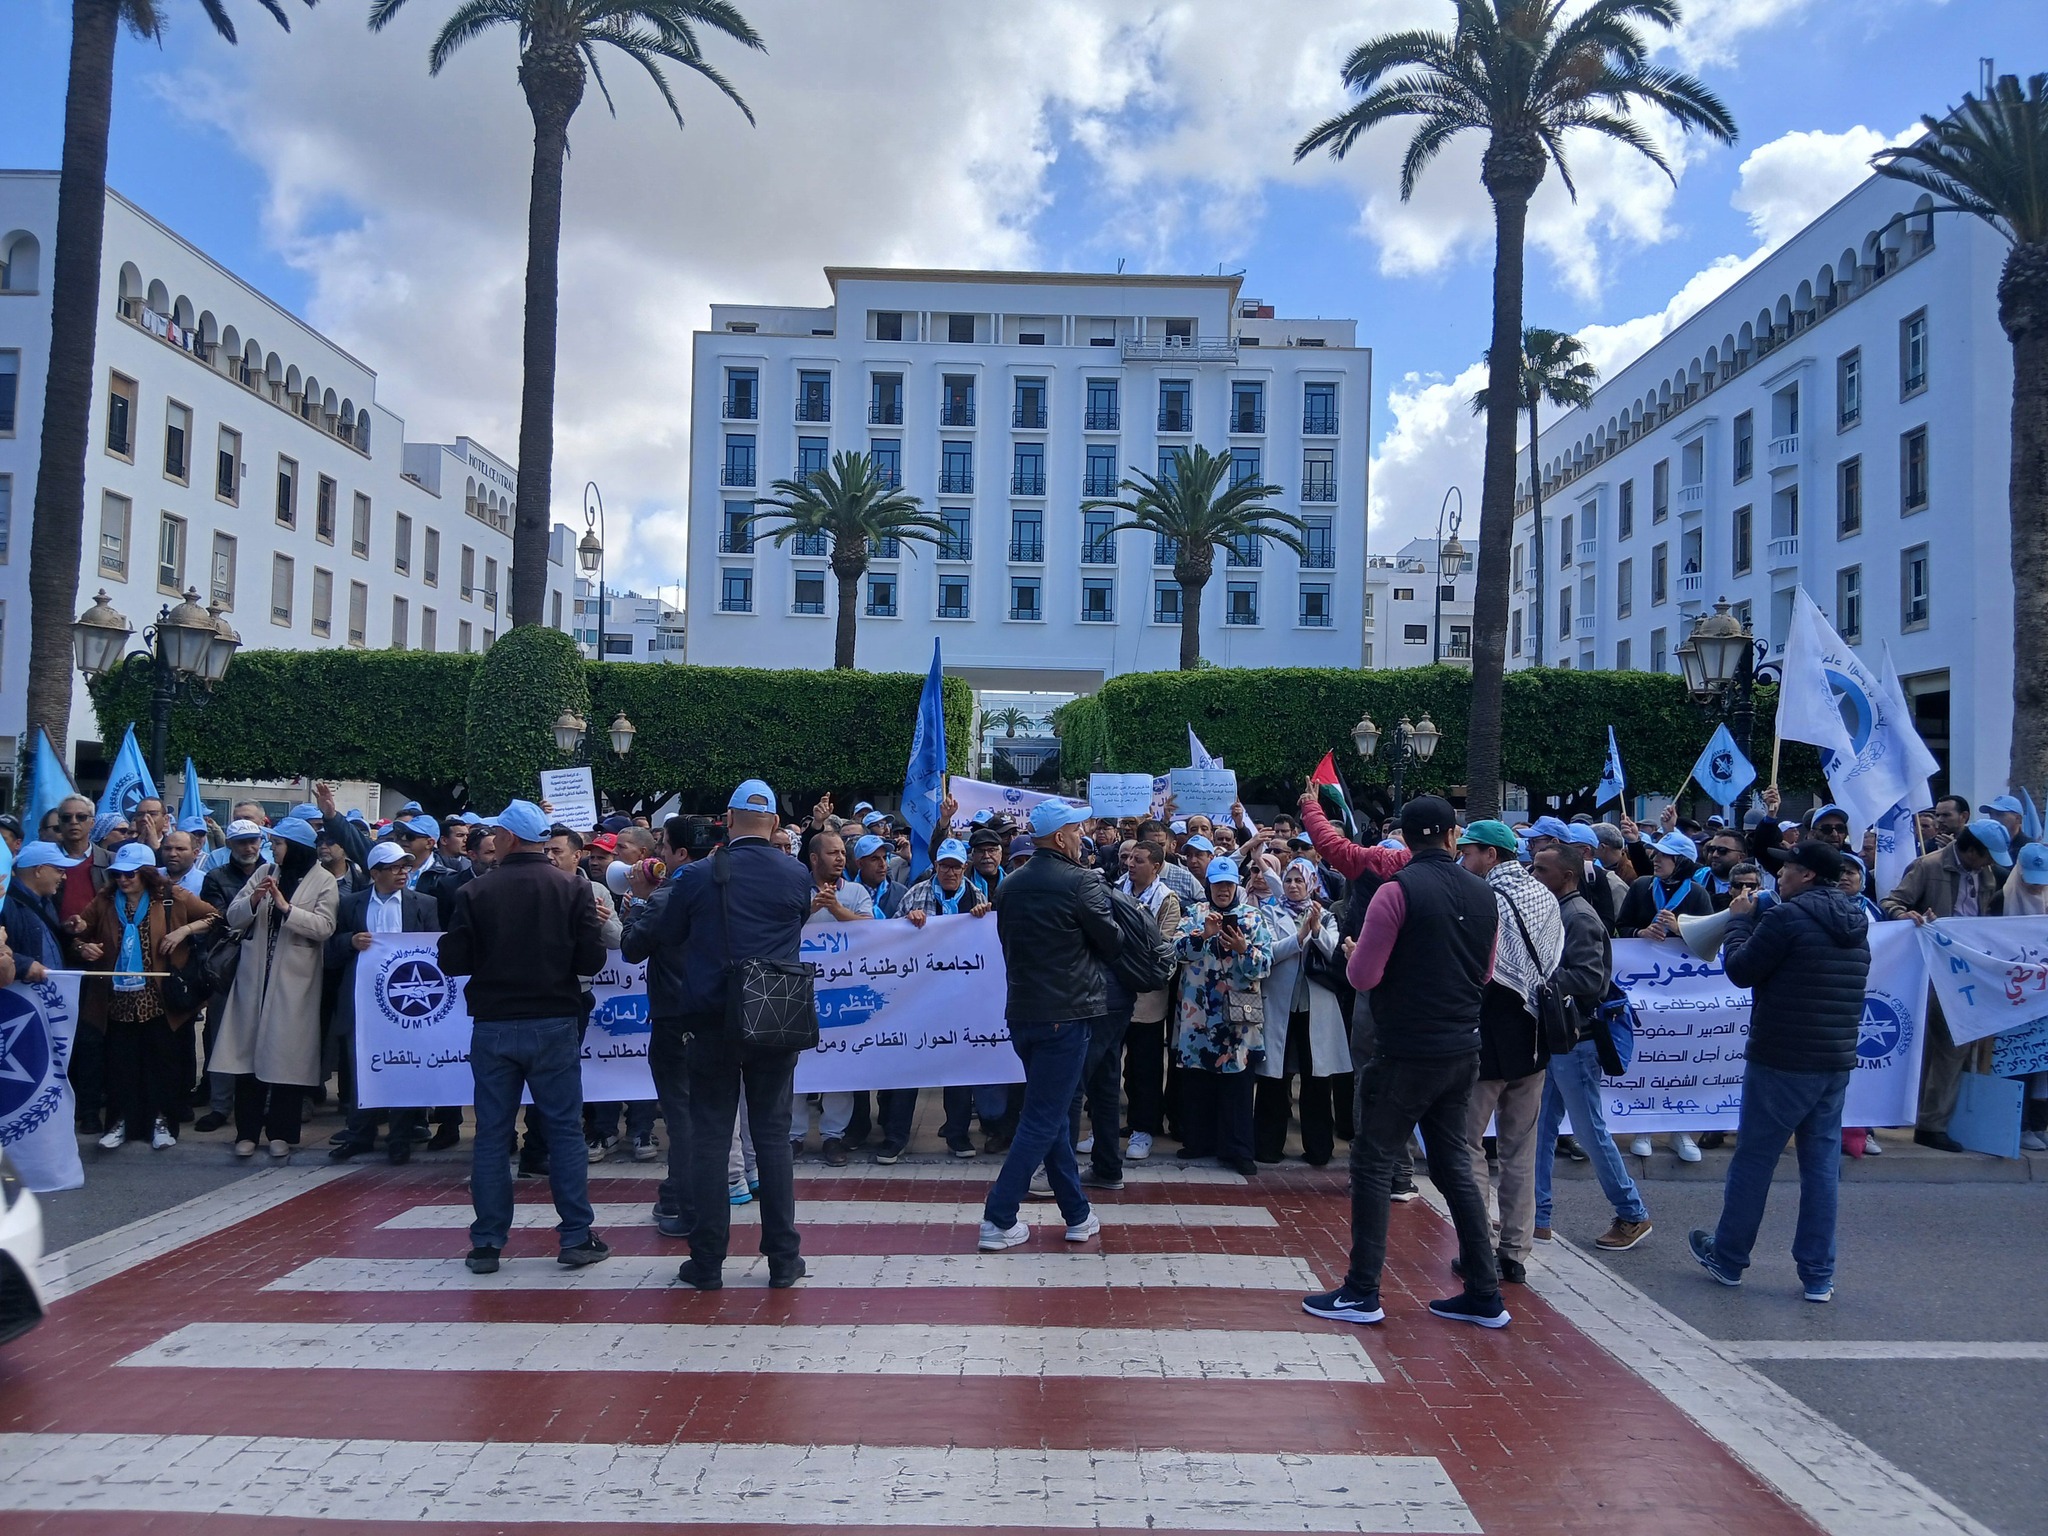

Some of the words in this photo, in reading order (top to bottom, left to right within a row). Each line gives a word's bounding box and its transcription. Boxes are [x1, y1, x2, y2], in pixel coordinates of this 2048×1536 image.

[469, 453, 489, 477] HOTEL
[489, 467, 515, 494] CENTRAL
[800, 931, 849, 954] الاتح
[813, 960, 853, 982] لموظ
[859, 957, 919, 981] الوطنية
[926, 953, 985, 975] الجامعة
[1615, 952, 1725, 991] لمغربي
[838, 993, 875, 1020] تنظم
[1653, 996, 1720, 1013] لموظفي
[1725, 994, 1753, 1011] طنية
[401, 1016, 432, 1029] UMT
[601, 1002, 648, 1025] رلمان
[914, 1030, 957, 1050] الحوار
[1697, 1022, 1735, 1039] التدبير
[597, 1043, 647, 1062] لمطالب
[816, 1038, 847, 1053] ومن
[851, 1032, 908, 1055] القطاعي
[370, 1049, 422, 1073] بالقطاع
[427, 1049, 471, 1069] عاملين
[1637, 1050, 1688, 1063] الحفاظ
[1693, 1046, 1720, 1064] أجل
[1610, 1097, 1655, 1116] الشرق
[1662, 1097, 1700, 1114] جهة
[1706, 1094, 1742, 1114] جلس
